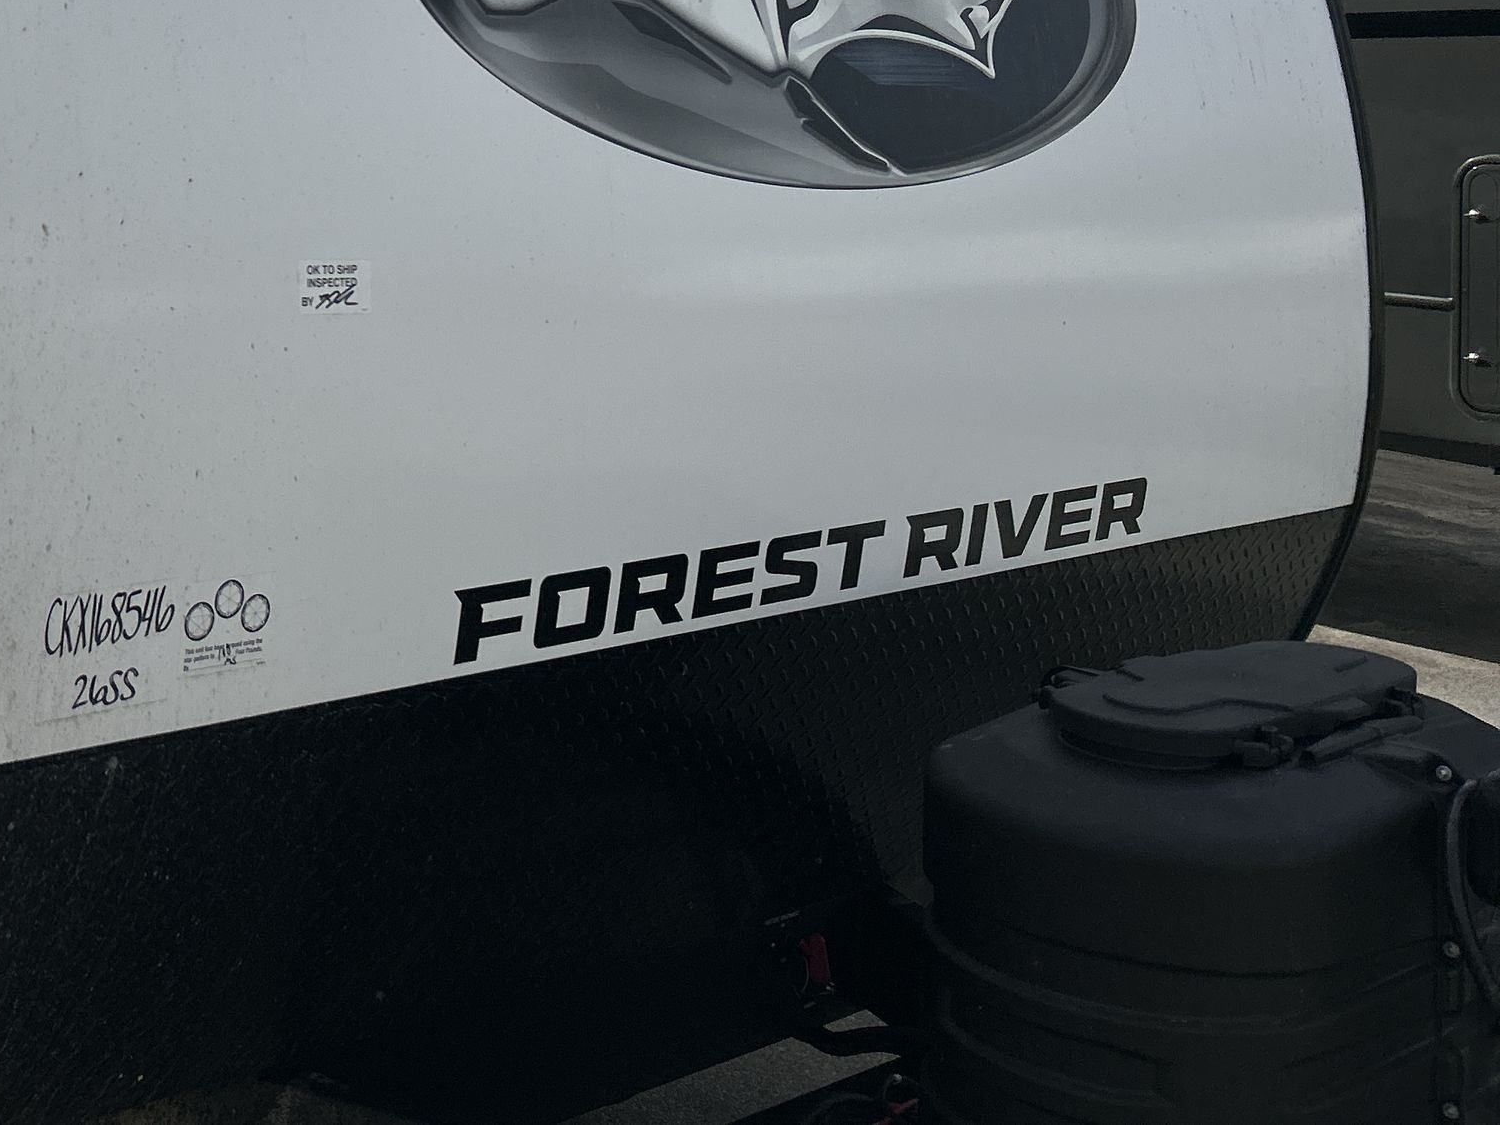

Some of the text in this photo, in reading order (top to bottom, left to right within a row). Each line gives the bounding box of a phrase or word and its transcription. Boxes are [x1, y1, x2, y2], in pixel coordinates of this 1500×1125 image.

[306, 264, 358, 275] OK TO SHIP
[306, 277, 358, 288] INSPECTED
[301, 296, 315, 307] BY
[452, 477, 1148, 665] FOREST RIVER
